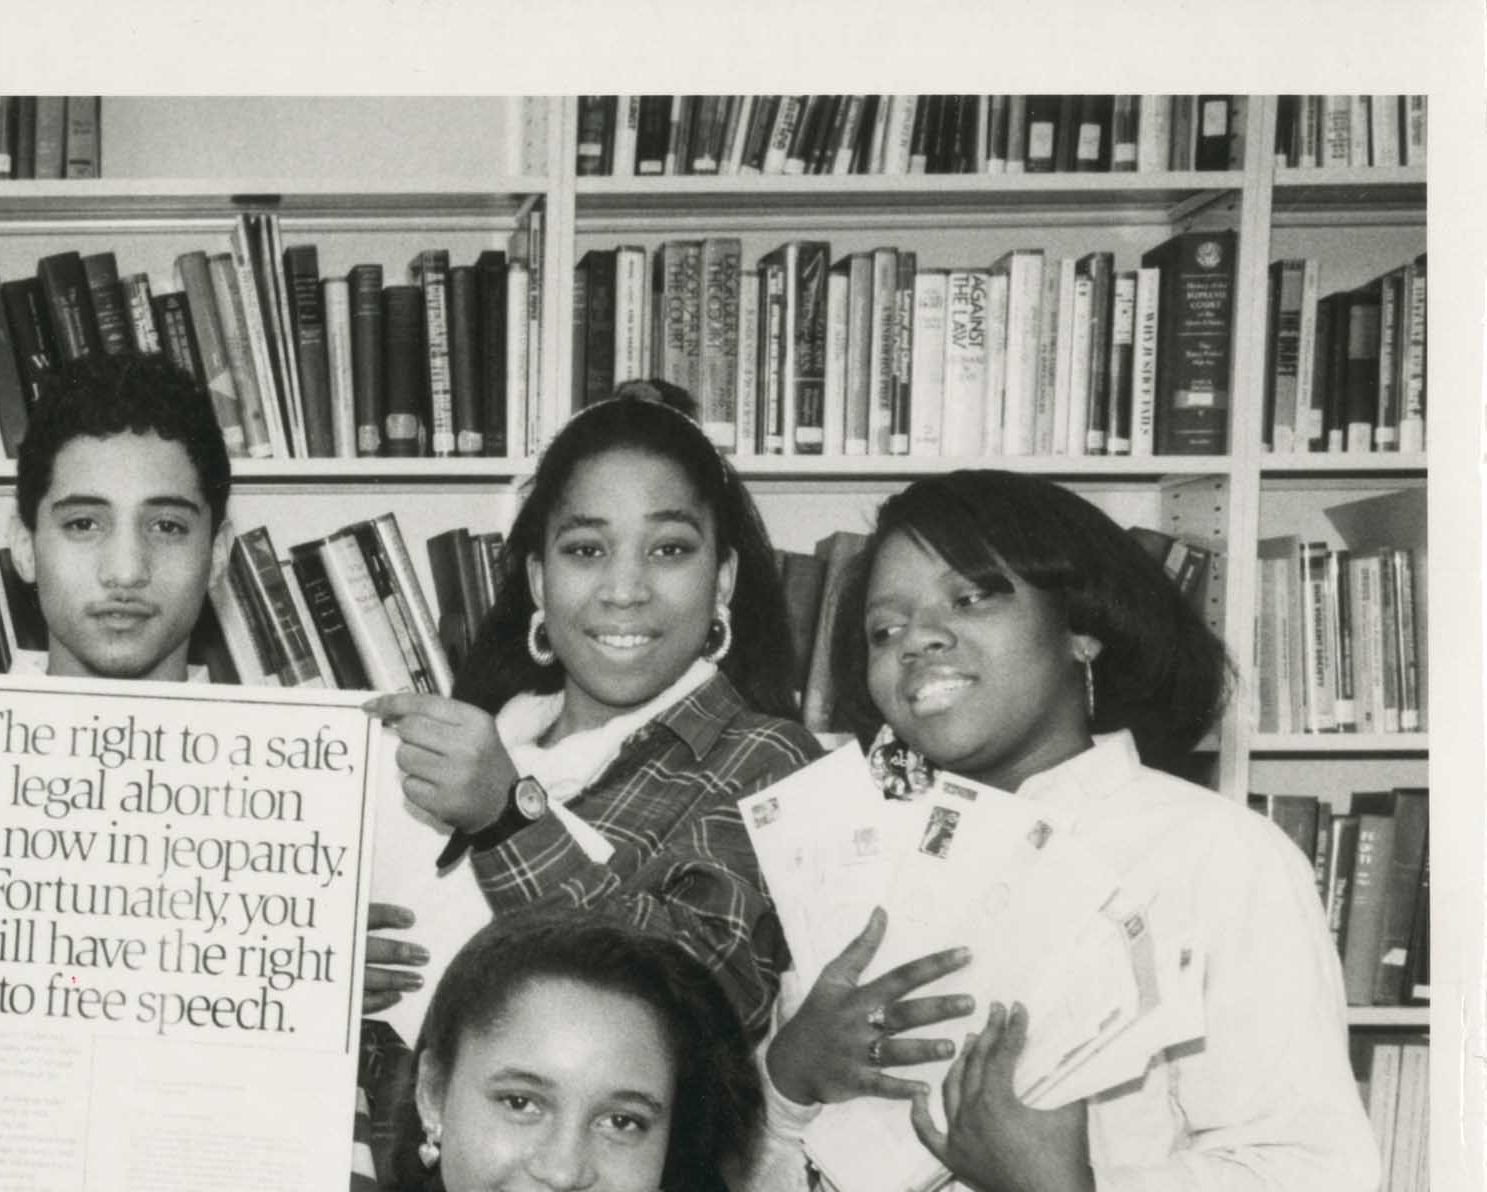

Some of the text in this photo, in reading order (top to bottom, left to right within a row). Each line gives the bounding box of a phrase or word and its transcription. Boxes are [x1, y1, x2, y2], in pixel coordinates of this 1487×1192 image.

[427, 284, 449, 353] COVENANT
[666, 262, 683, 352] THE COURT
[951, 275, 968, 349] THE LAW
[970, 275, 987, 348] AGAINST
[1142, 312, 1155, 342] WHY
[430, 355, 450, 391] WITH
[1278, 335, 1297, 378] DRAFT
[1315, 648, 1325, 688] SOCIETY
[70, 715, 165, 768] right
[180, 726, 218, 764] to
[229, 735, 252, 766] a
[266, 725, 354, 773] safe,
[11, 764, 303, 821] legal abortion
[3, 827, 97, 861] now
[107, 821, 148, 864] in
[163, 824, 347, 888] jeopardy.
[239, 893, 315, 935] you
[48, 921, 146, 970] have
[159, 929, 226, 976] the
[237, 935, 335, 991] right
[46, 972, 126, 1021] free
[136, 986, 295, 1035] speech.
